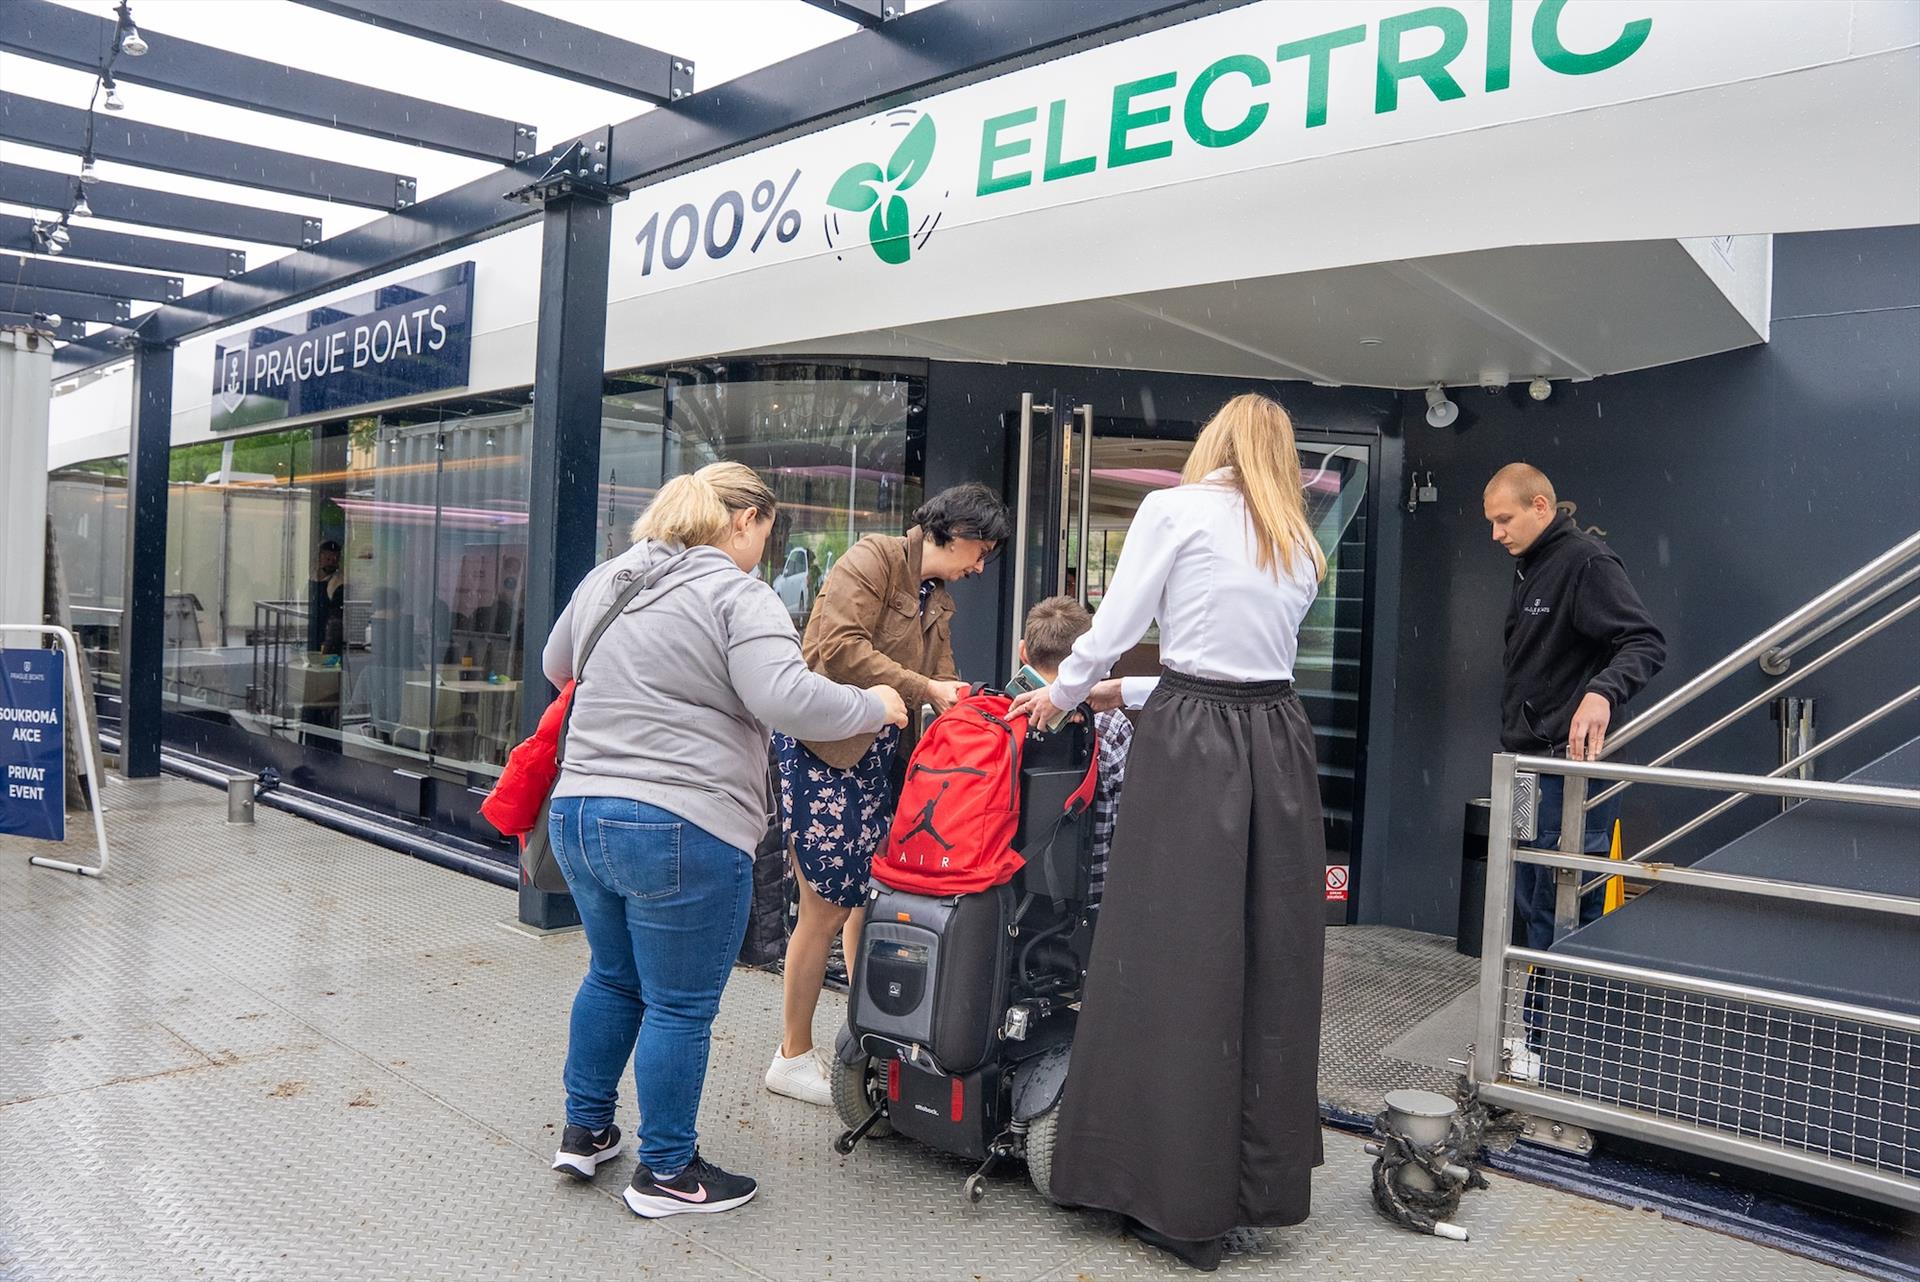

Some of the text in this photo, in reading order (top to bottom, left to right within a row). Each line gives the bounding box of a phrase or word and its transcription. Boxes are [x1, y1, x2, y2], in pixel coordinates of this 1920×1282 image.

[635, 0, 1652, 276] 100% ELECTRIC
[253, 304, 448, 391] PRAGUE BOATS
[12, 727, 41, 742] AKCE
[8, 764, 46, 781] PRIVAT
[9, 784, 45, 800] EVENT
[899, 851, 949, 868] AIR
